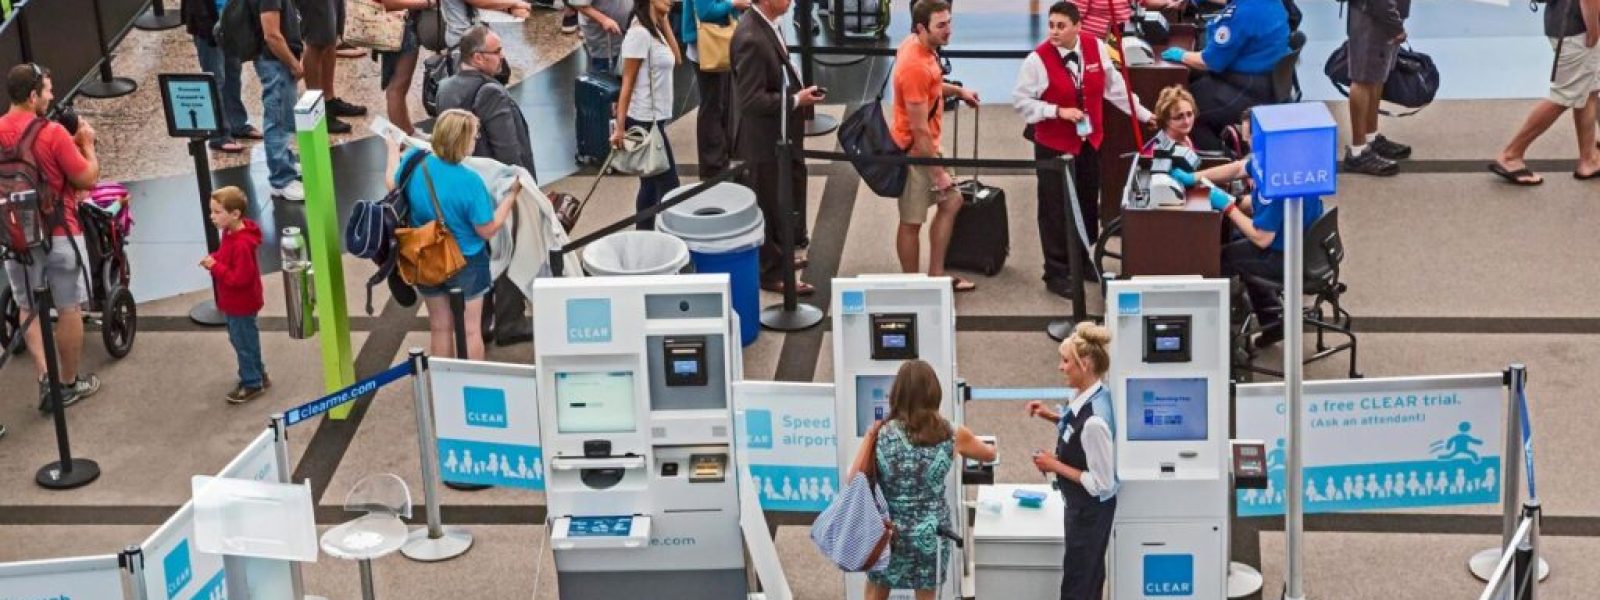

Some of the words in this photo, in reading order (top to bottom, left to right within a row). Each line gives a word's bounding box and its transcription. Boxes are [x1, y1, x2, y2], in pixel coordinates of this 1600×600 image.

[1270, 169, 1329, 187] CLEAR
[568, 327, 609, 338] CLEAR
[301, 380, 376, 418] clearme.com
[1308, 403, 1318, 413] a
[1324, 400, 1354, 412] free
[1360, 394, 1418, 411] CLEAR
[1423, 393, 1462, 407] trial.
[468, 411, 505, 423] CLEAR
[782, 414, 831, 430] Speed
[1310, 416, 1338, 429] (Ask
[1343, 418, 1357, 427] an
[1360, 413, 1426, 426] attendant)
[782, 432, 838, 448] airport
[168, 568, 191, 595] CLEAR
[1146, 582, 1190, 593] CLEAR
